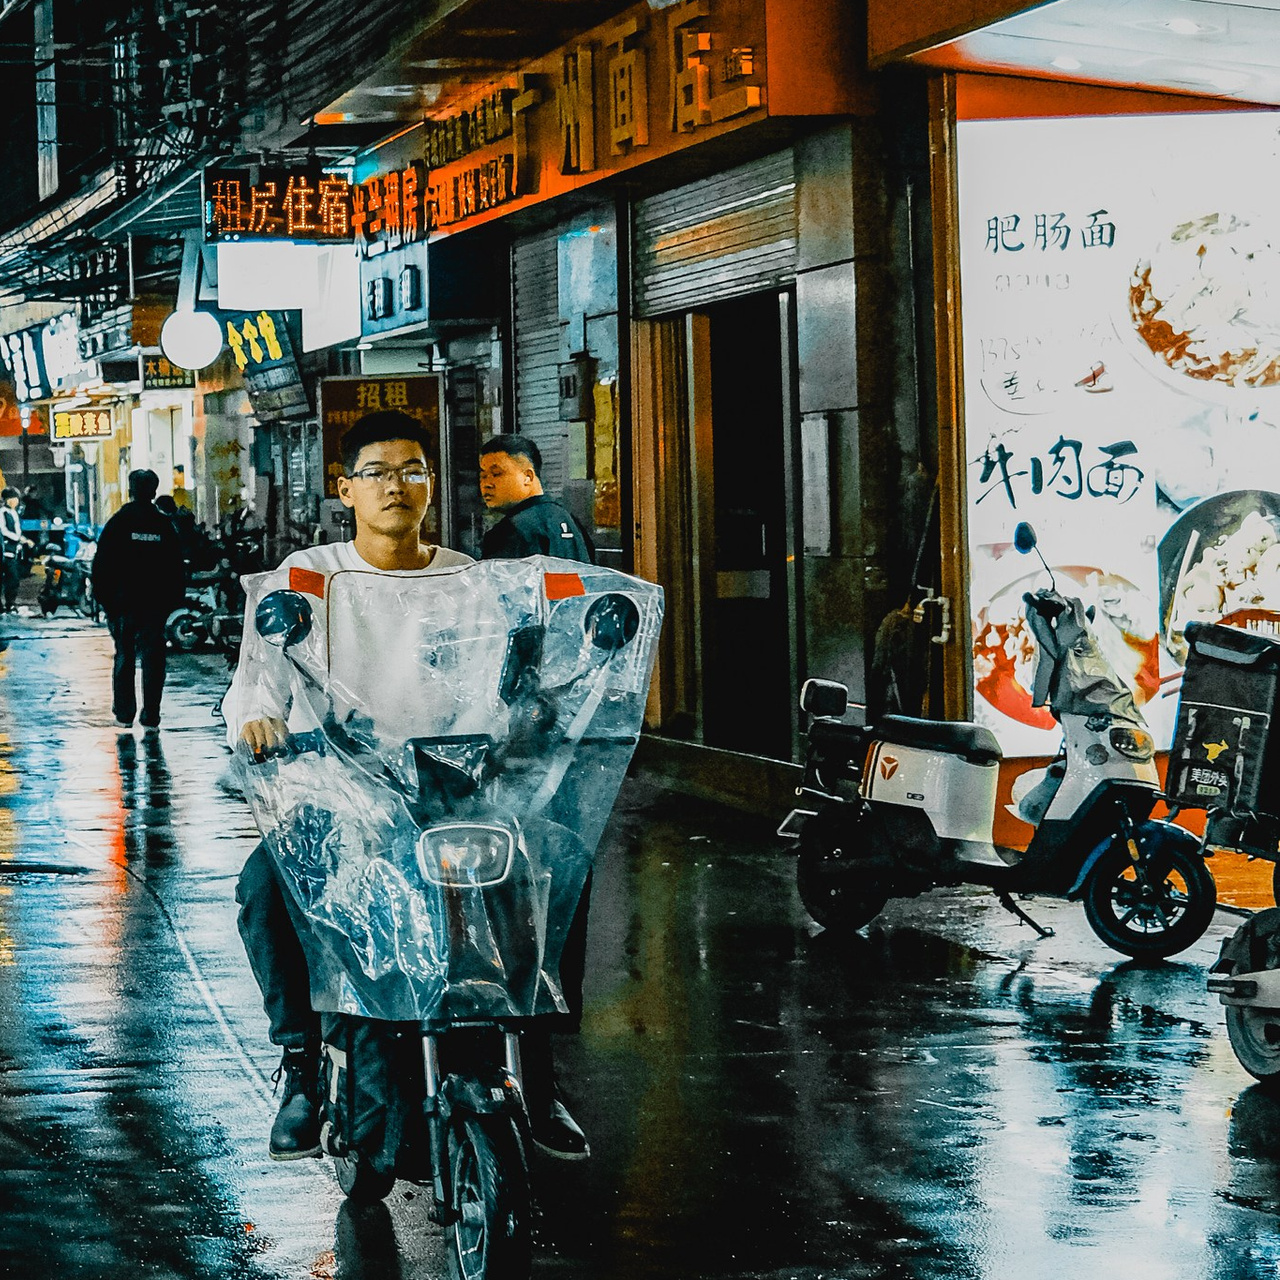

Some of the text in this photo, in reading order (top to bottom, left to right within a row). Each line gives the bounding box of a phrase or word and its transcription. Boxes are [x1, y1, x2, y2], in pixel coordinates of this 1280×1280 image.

[984, 209, 1117, 254] 肥肠面
[356, 381, 408, 408] 招租
[974, 434, 1145, 510] 牛肉面
[1190, 767, 1228, 787] 美团外卖
